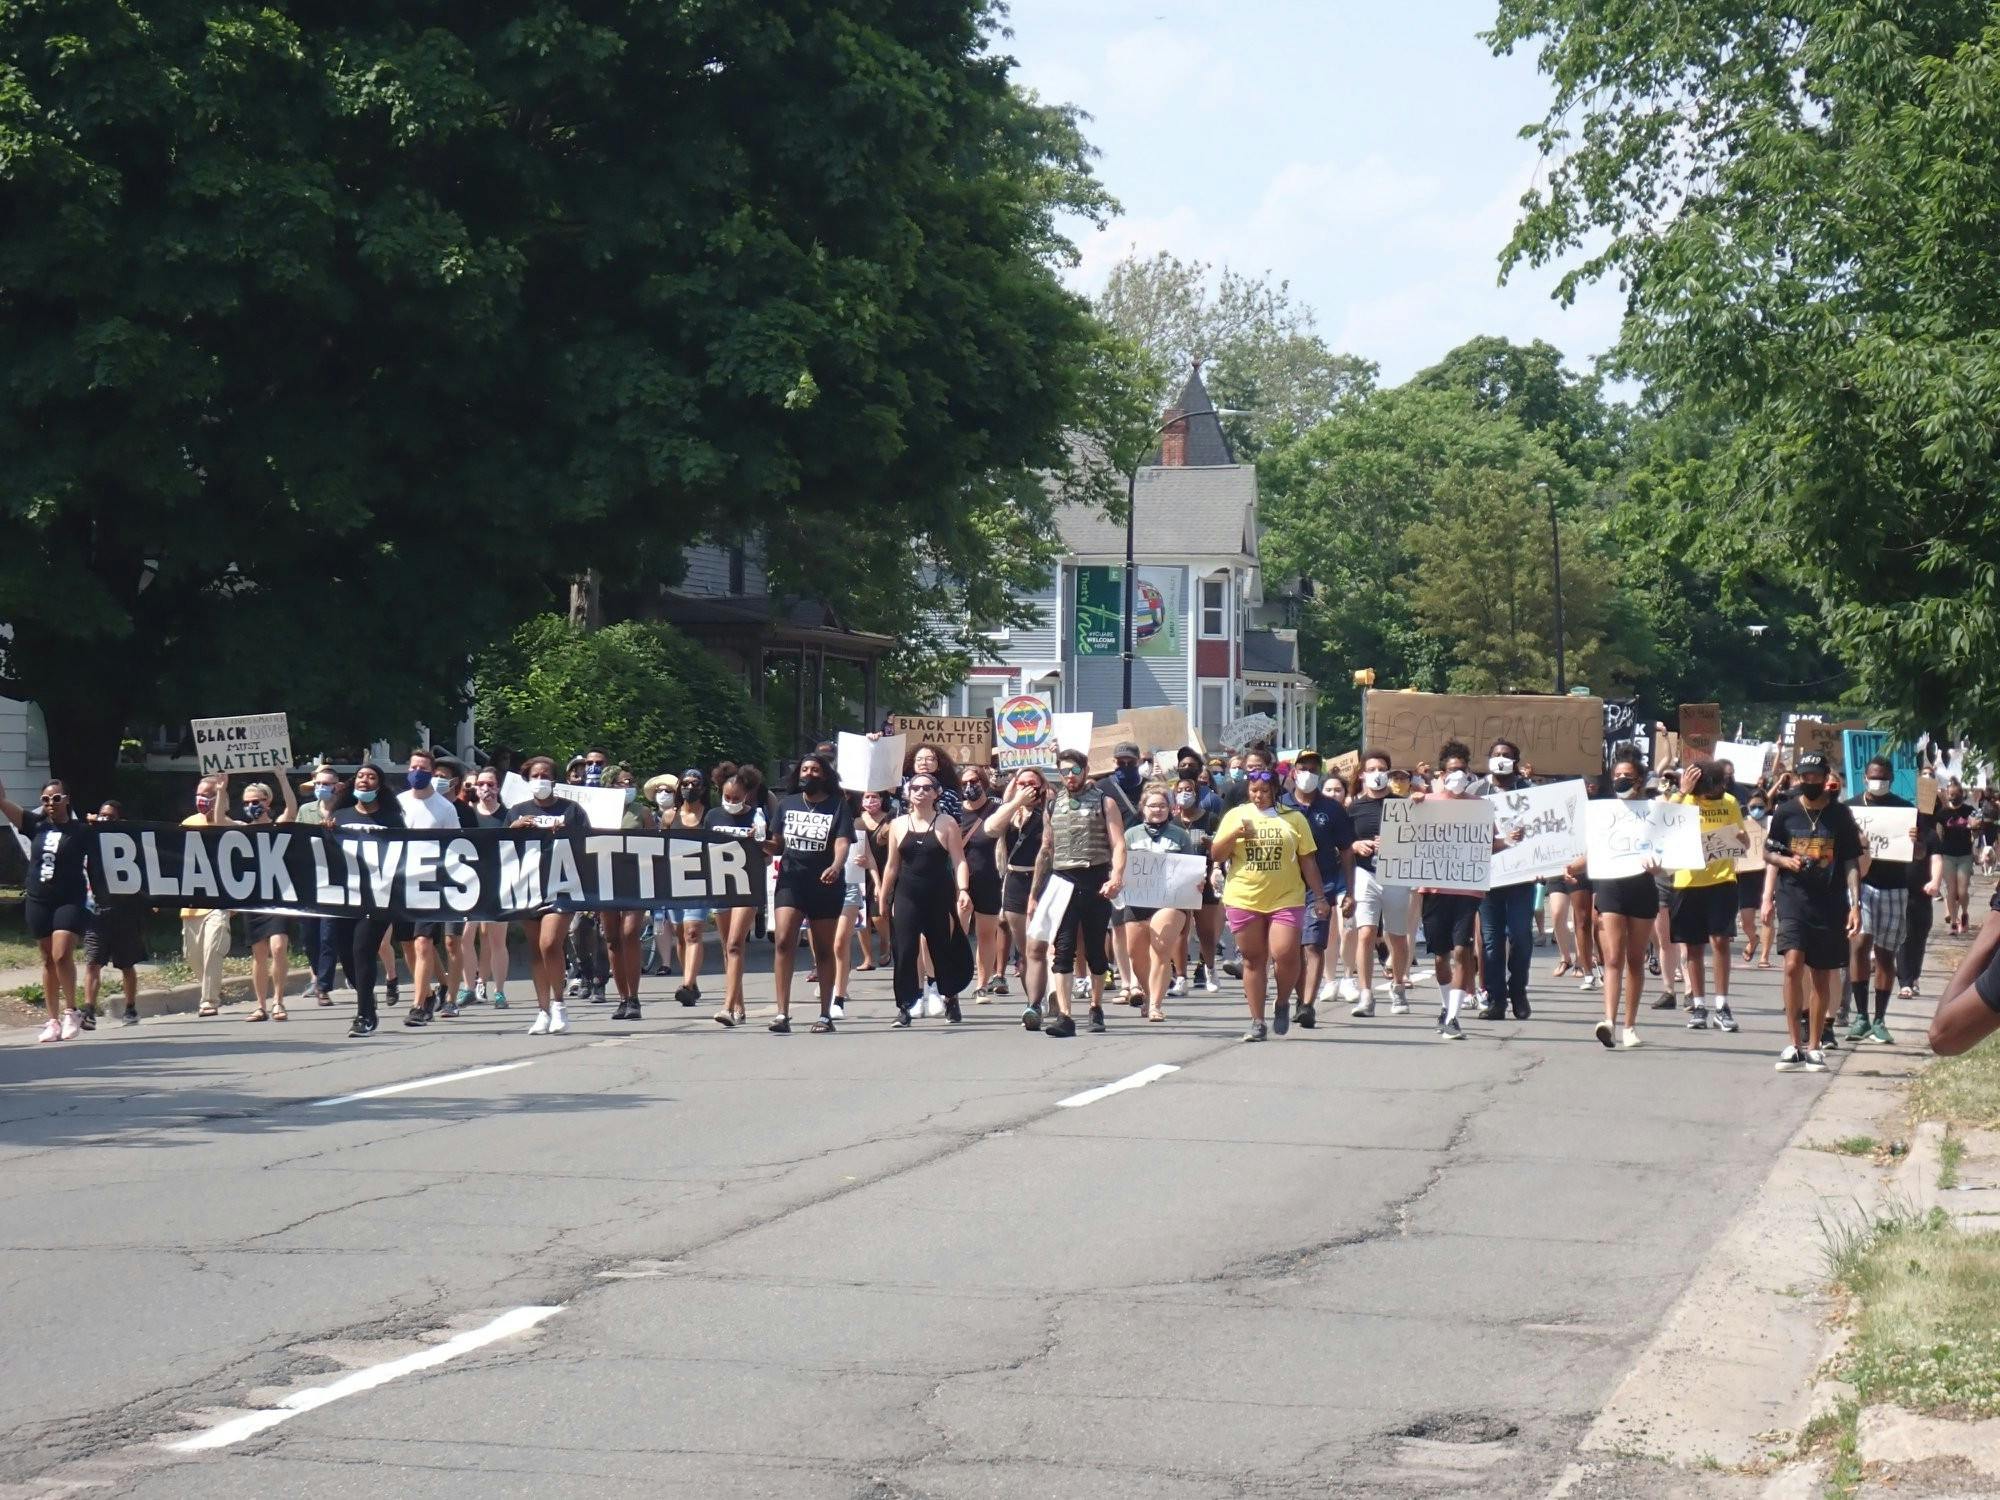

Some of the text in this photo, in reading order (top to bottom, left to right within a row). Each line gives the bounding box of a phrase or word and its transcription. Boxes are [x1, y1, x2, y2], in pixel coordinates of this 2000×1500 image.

[900, 718, 990, 734] BLACK LIVES
[196, 727, 248, 743] BLACK
[922, 733, 983, 745] MATTER
[227, 741, 260, 752] MUST
[203, 747, 289, 775] MATTER!
[1800, 754, 1822, 765] 1619
[787, 813, 830, 826] BLACK
[1383, 801, 1414, 823] MY
[1664, 813, 1687, 828] UP
[786, 824, 828, 840] LIVES
[1398, 823, 1492, 844] EXECUTION
[1260, 839, 1284, 847] WORLD
[1245, 846, 1284, 862] BOYS
[1414, 844, 1491, 863] MIGHT BE
[1708, 848, 1746, 861] ATTER
[100, 830, 752, 911] BLACK LIVES MATTER
[1256, 861, 1283, 871] BLUE!
[1379, 855, 1486, 883] TELEVISED
